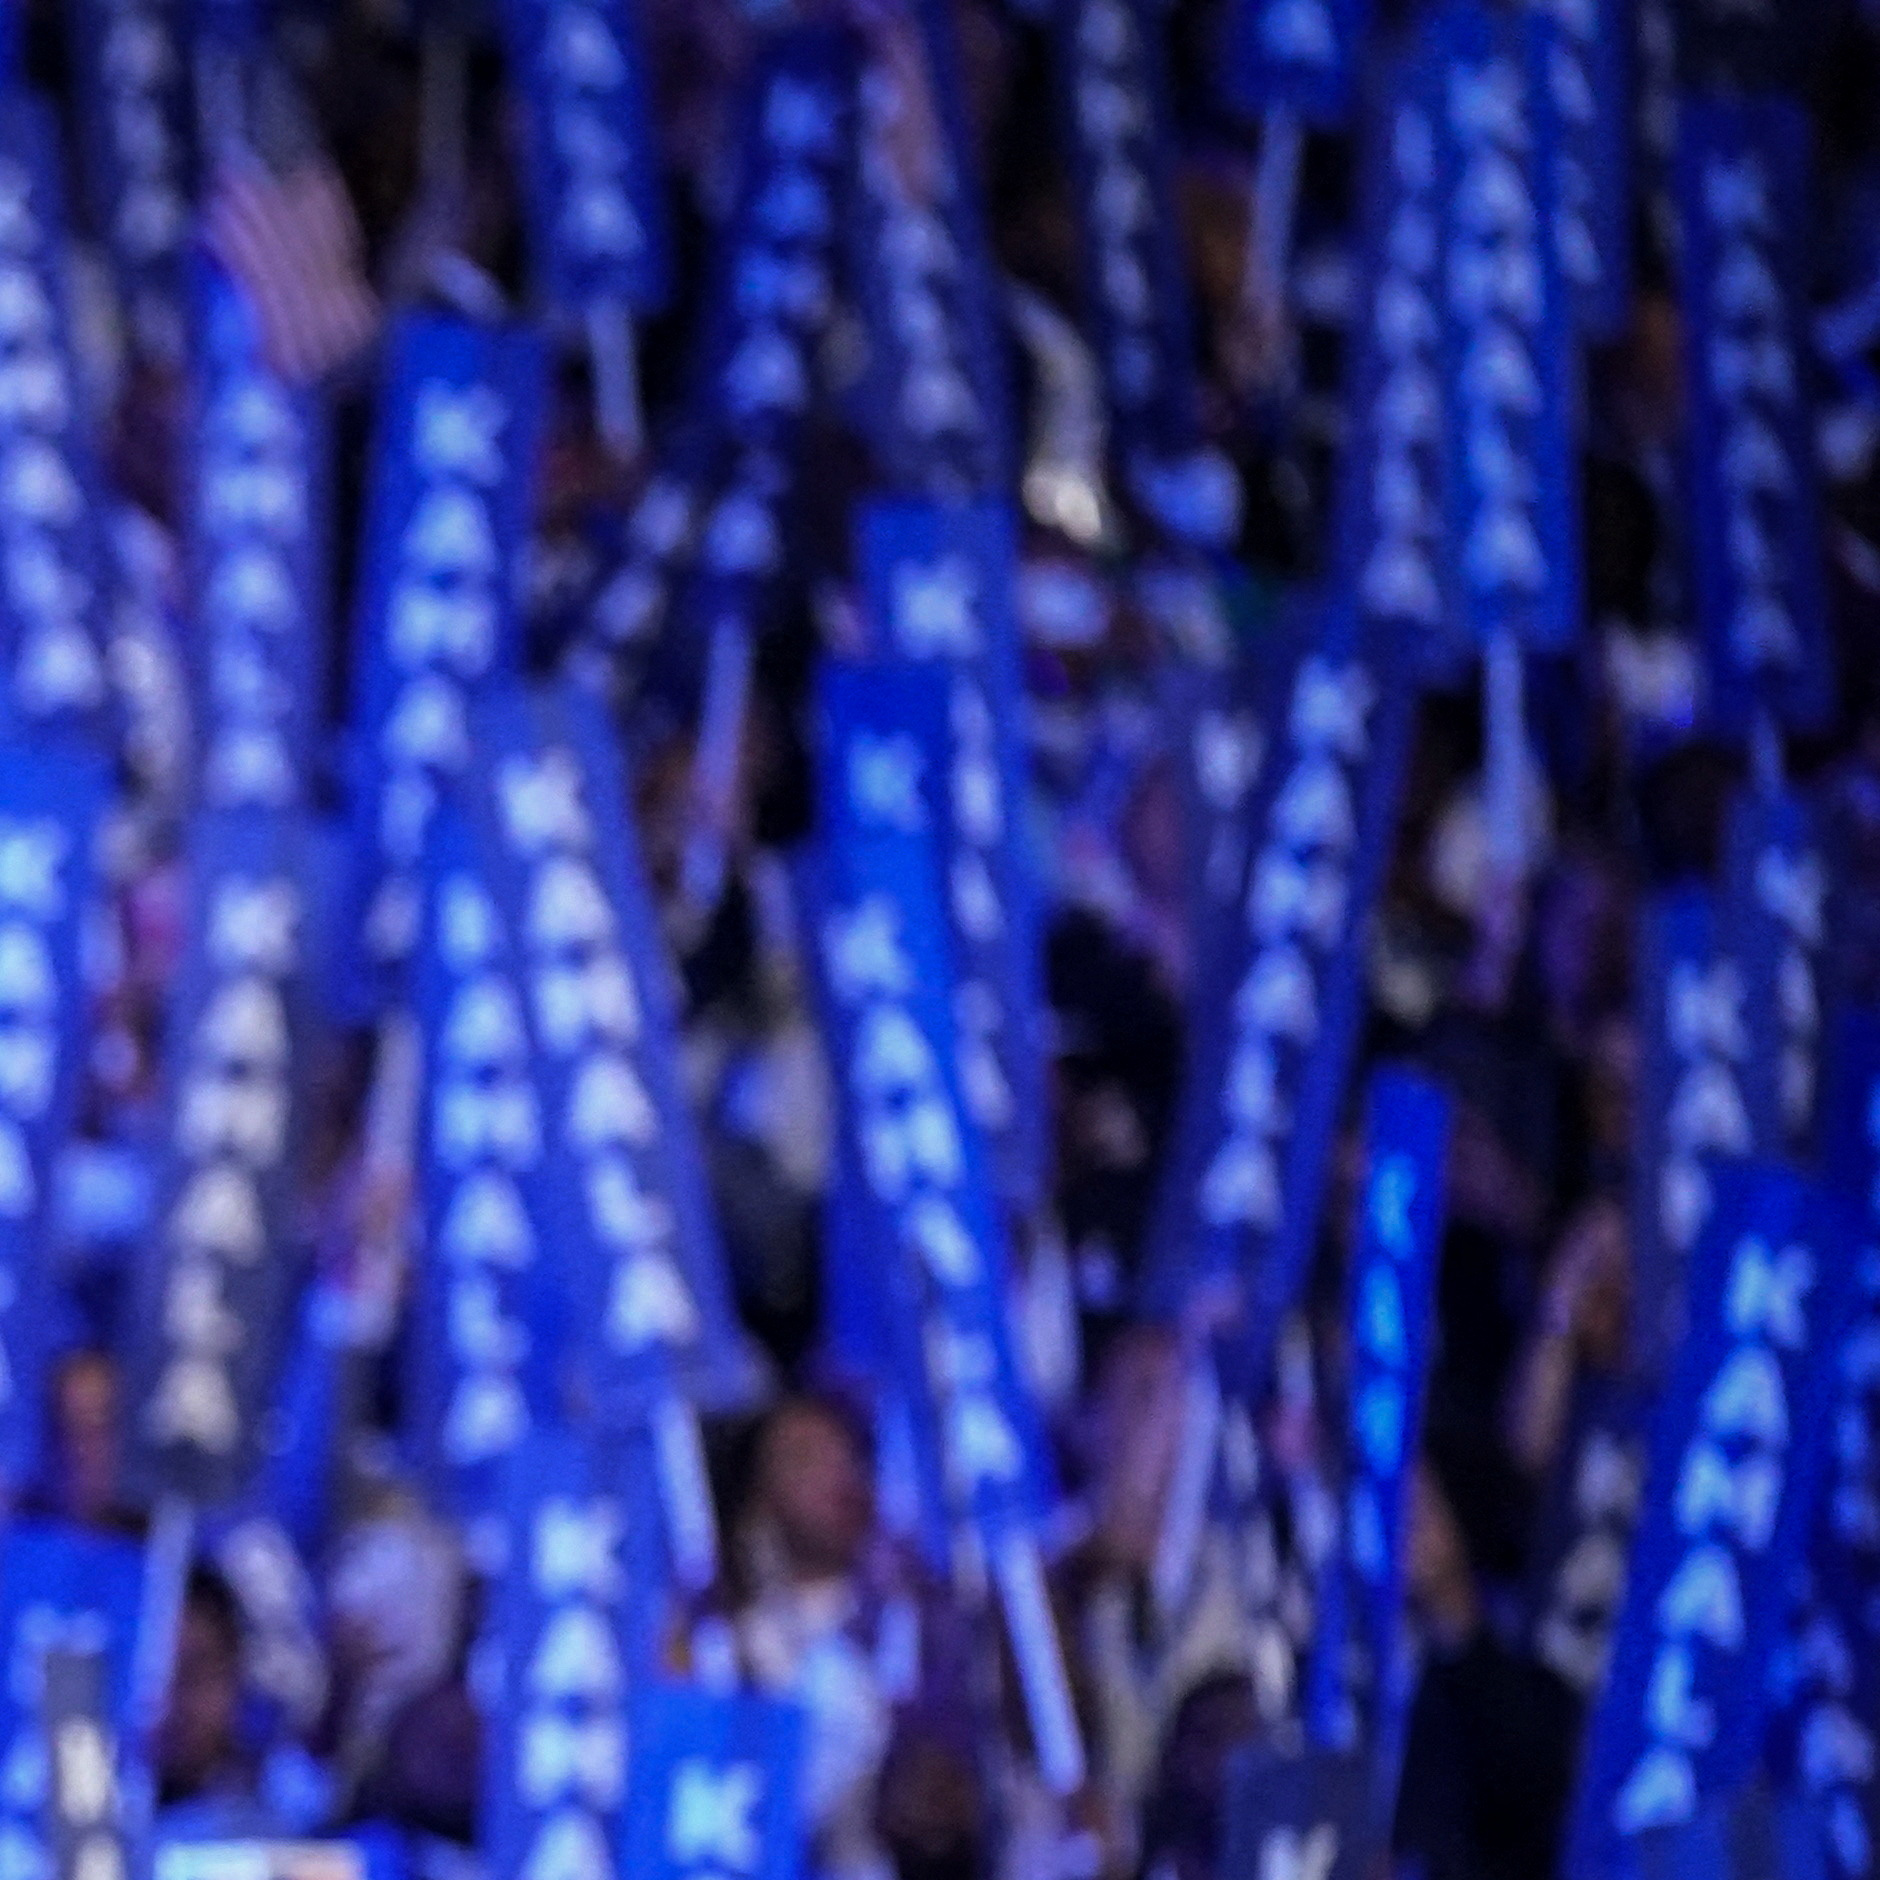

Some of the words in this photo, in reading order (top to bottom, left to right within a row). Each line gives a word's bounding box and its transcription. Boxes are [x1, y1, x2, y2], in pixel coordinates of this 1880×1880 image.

[148, 880, 300, 1457] KAMALA
[500, 748, 698, 1357] KAMALA
[1200, 655, 1375, 1232] KAMALA
